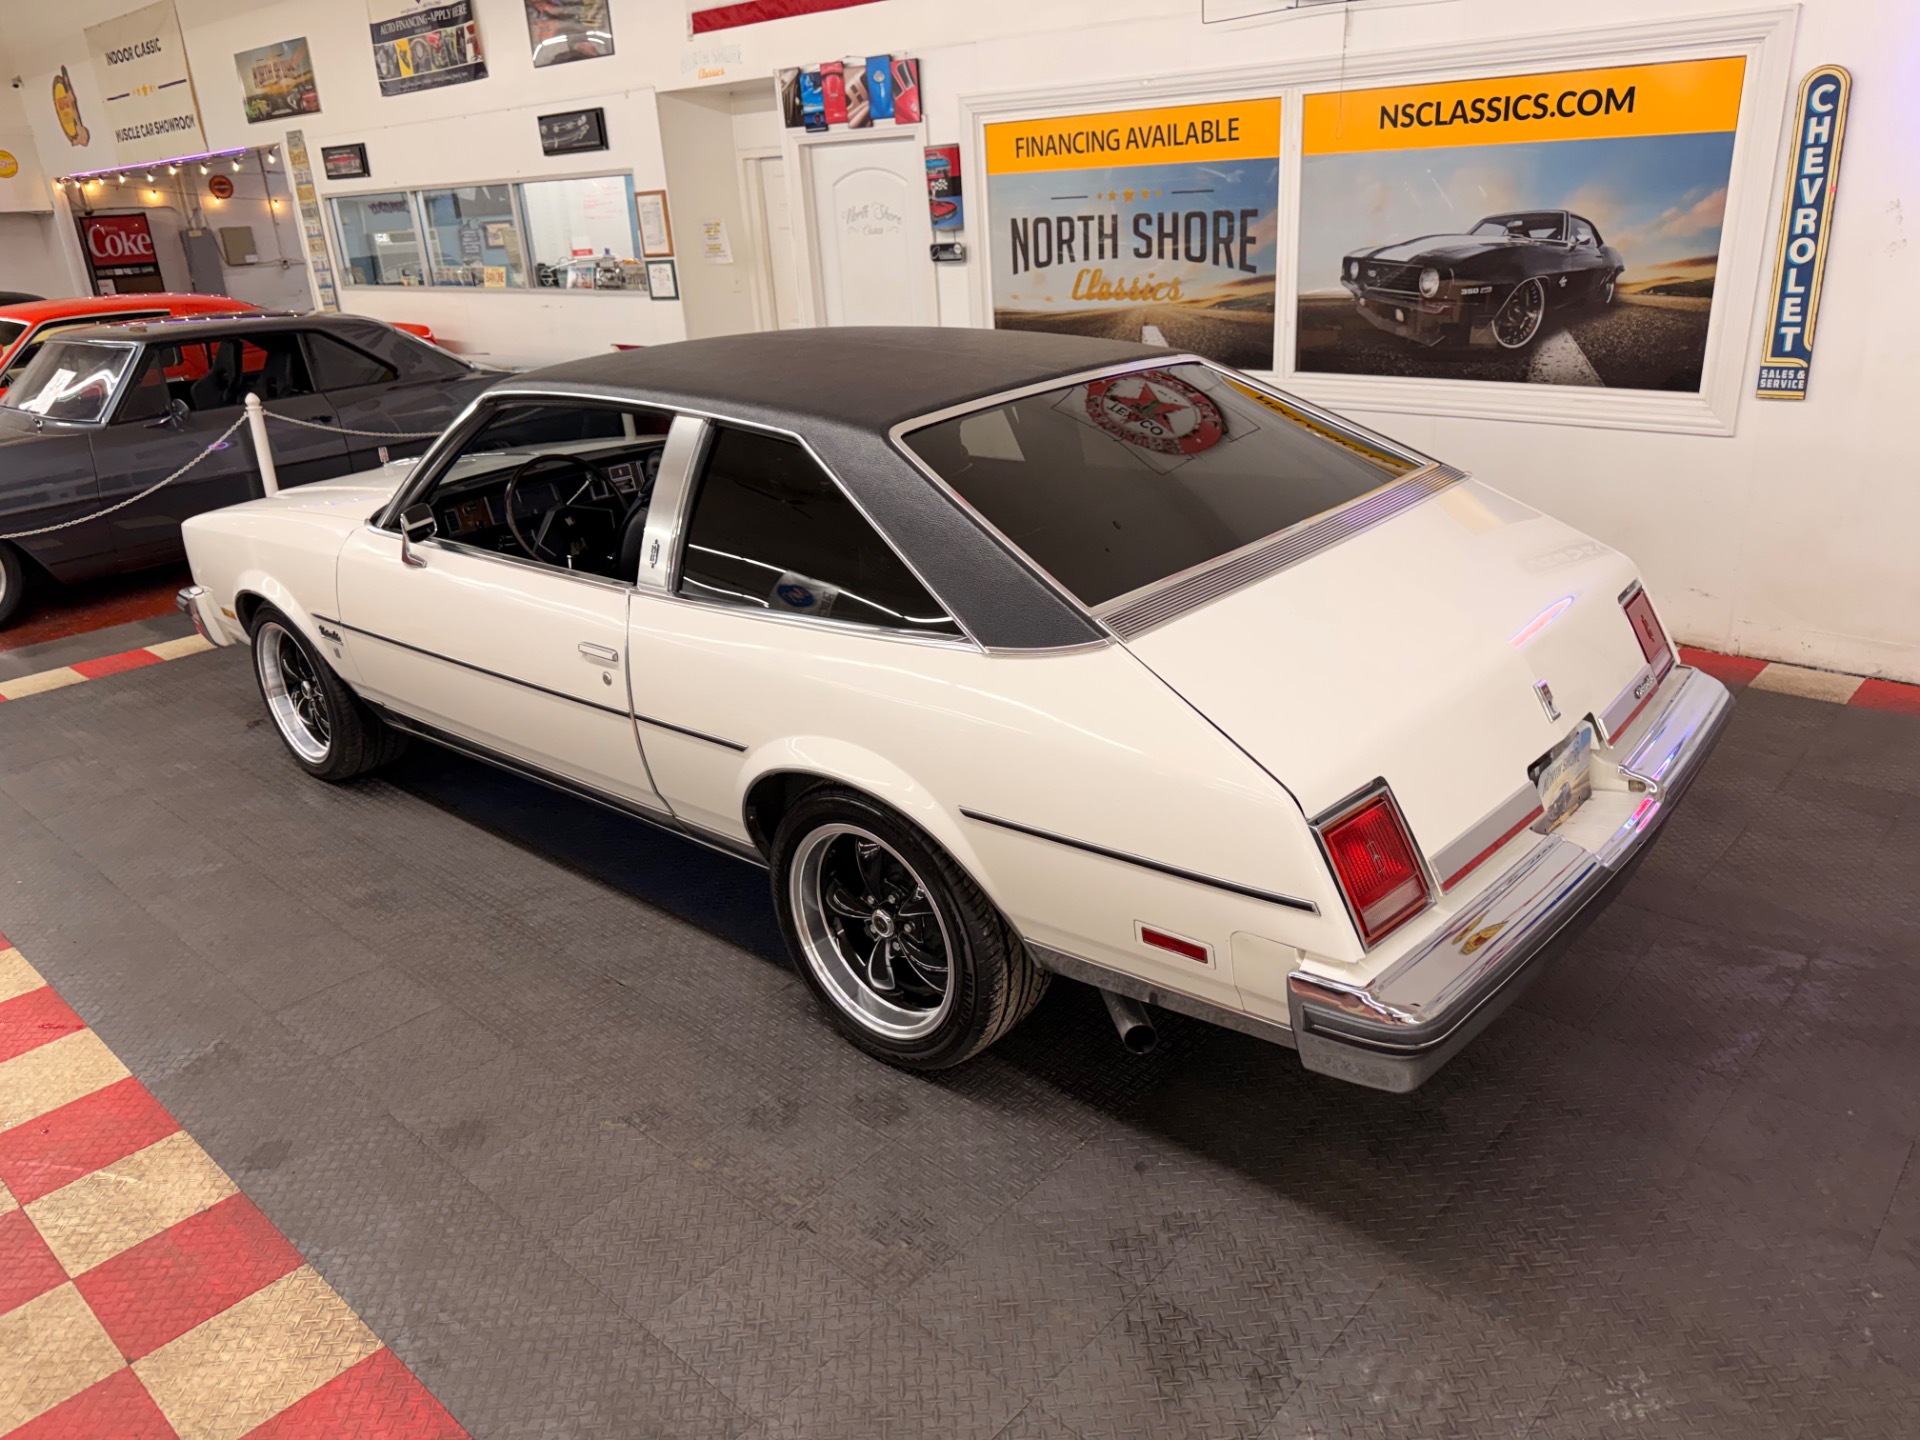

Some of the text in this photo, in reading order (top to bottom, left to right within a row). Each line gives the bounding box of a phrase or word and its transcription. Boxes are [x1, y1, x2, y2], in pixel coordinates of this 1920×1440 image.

[380, 22, 397, 35] AUTO
[451, 3, 468, 18] HERE
[105, 46, 135, 66] INDOOR
[1379, 85, 1637, 130] NSCLASSICS.COM
[115, 114, 196, 144] MUSCLE CAR SHOWROOM
[1015, 117, 1240, 159] FINANCING AVAILABLE
[1779, 83, 1837, 353] CHEVROLET
[88, 226, 153, 257] Coke
[1010, 208, 1258, 275] NORTH SHORE
[1071, 268, 1184, 302] Classics
[1759, 378, 1805, 389] SERVICE
[1761, 369, 1806, 379] SALES &
